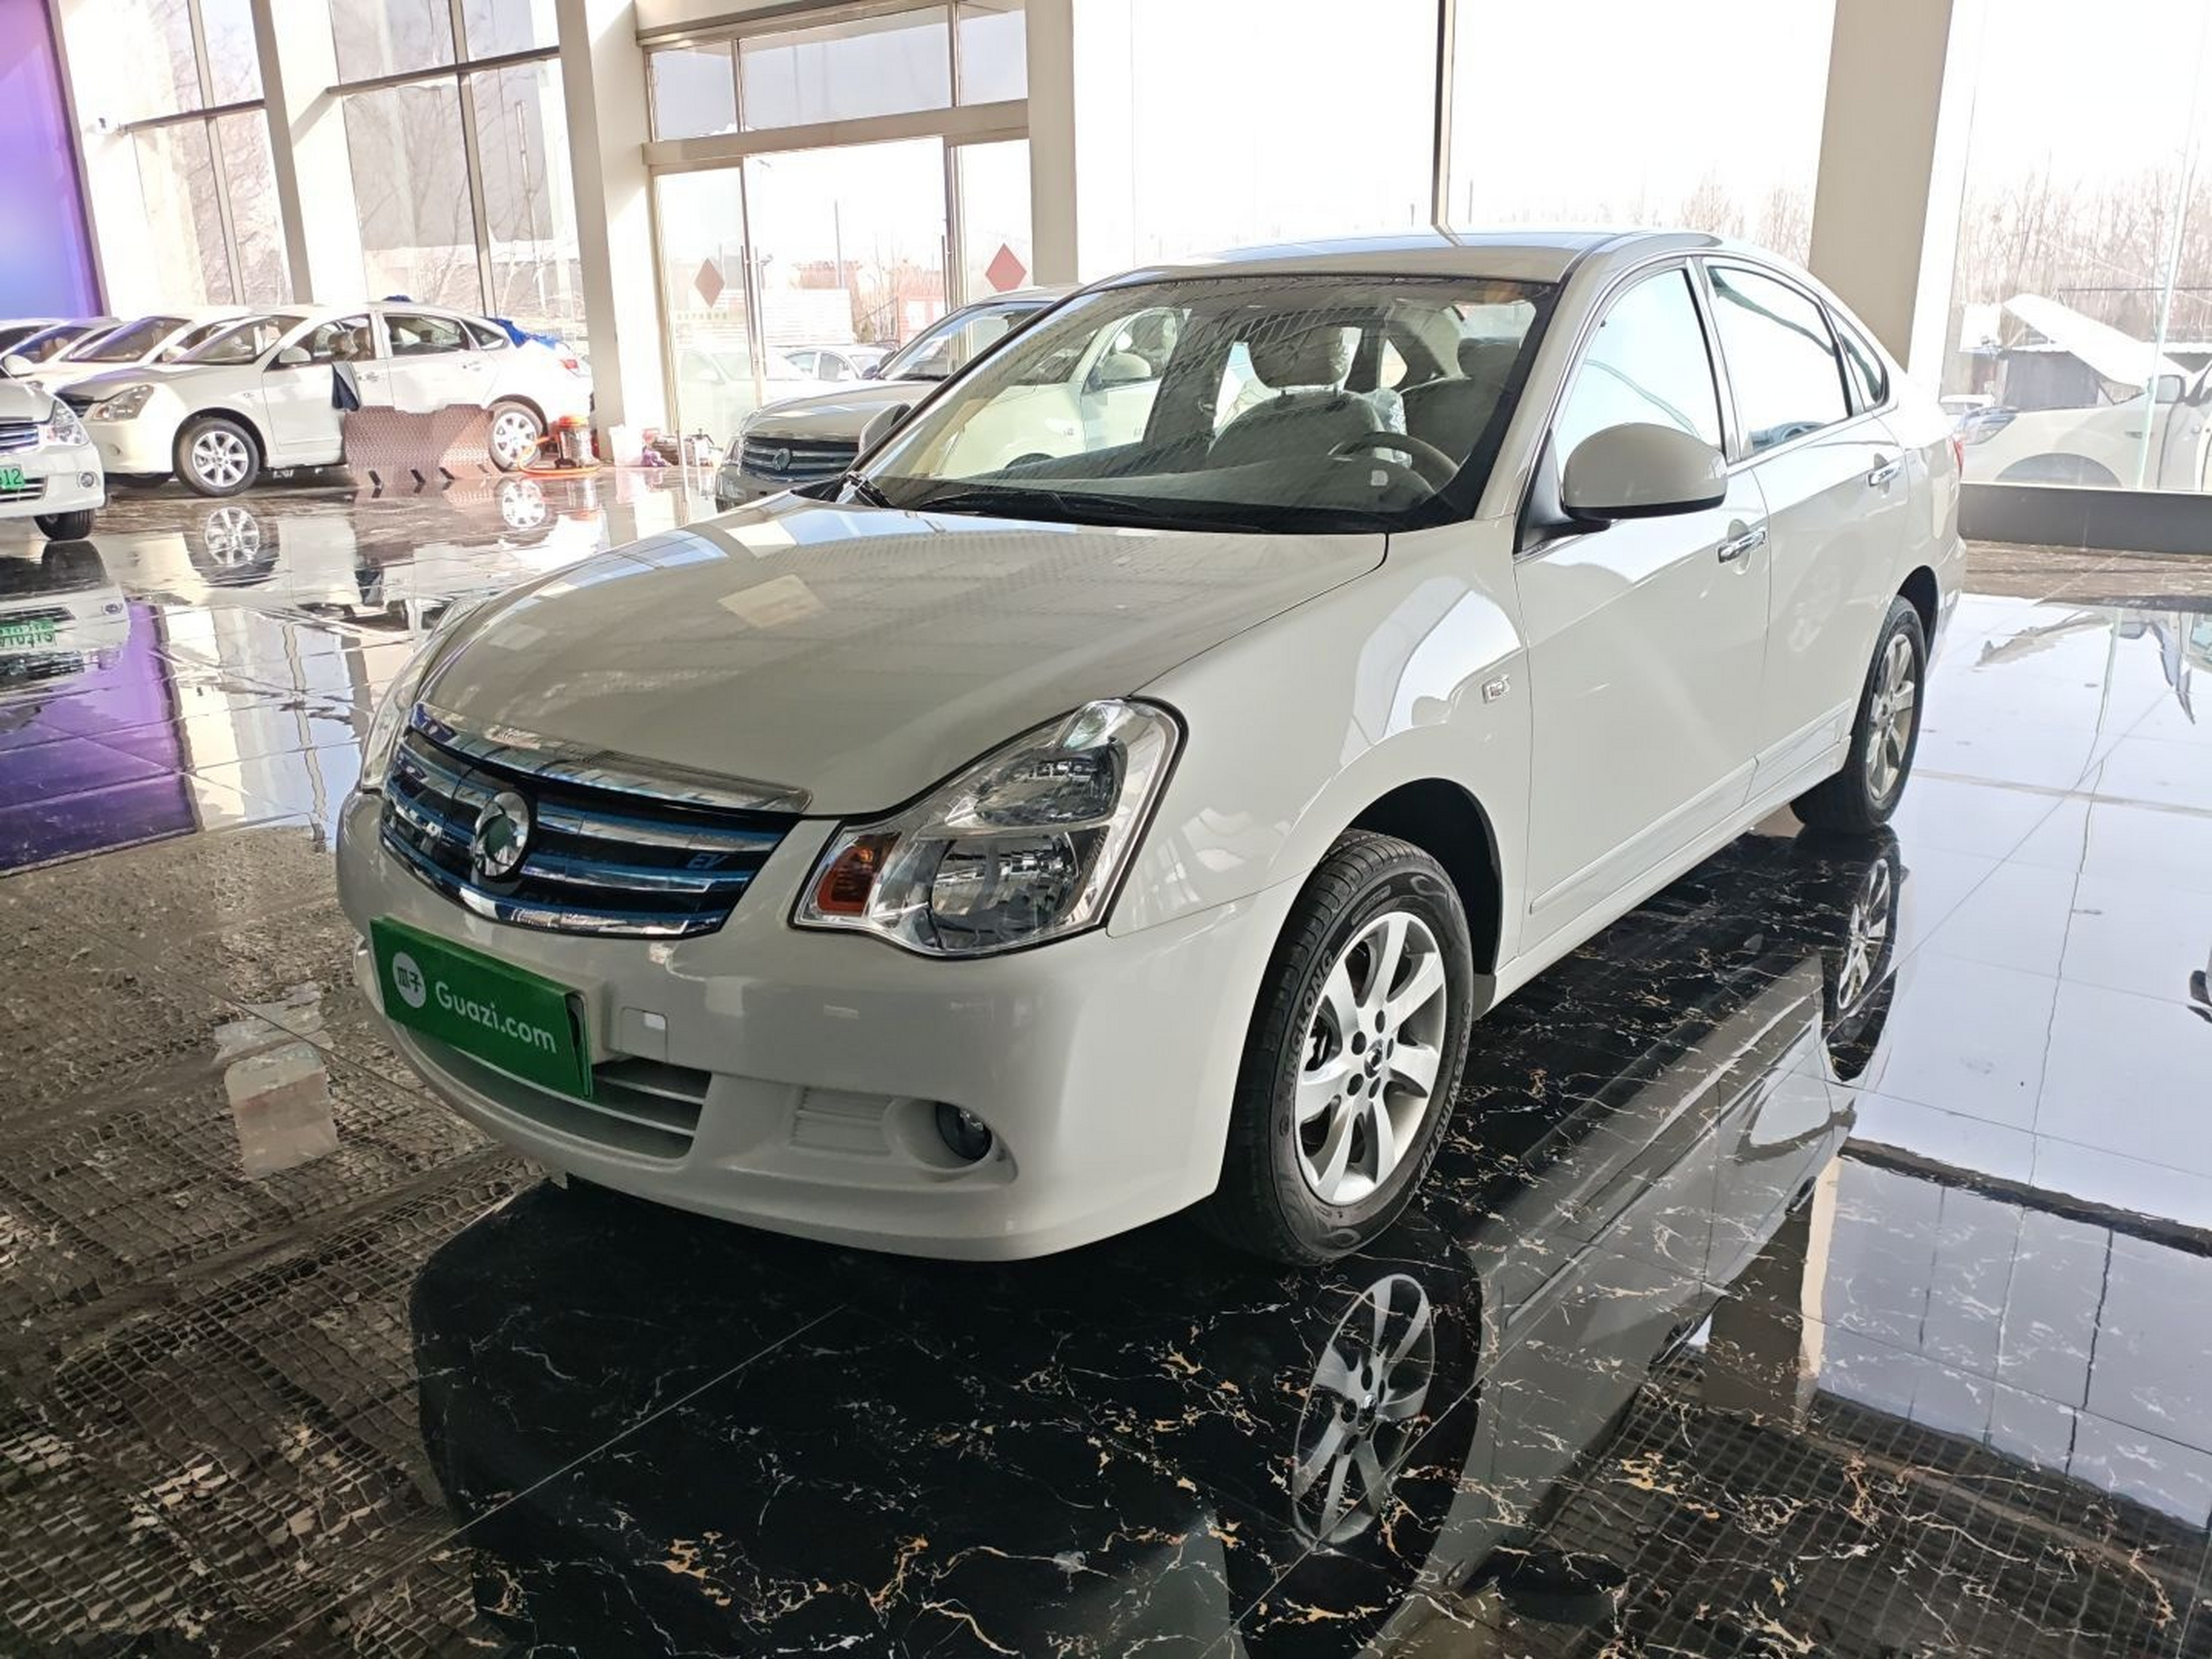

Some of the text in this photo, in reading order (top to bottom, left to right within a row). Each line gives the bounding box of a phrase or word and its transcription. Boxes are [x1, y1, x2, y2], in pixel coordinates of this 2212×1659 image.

[1, 468, 22, 485] 12
[688, 853, 729, 870] EV
[396, 966, 422, 994] 瓜子
[435, 980, 556, 1054] Guazi.com
